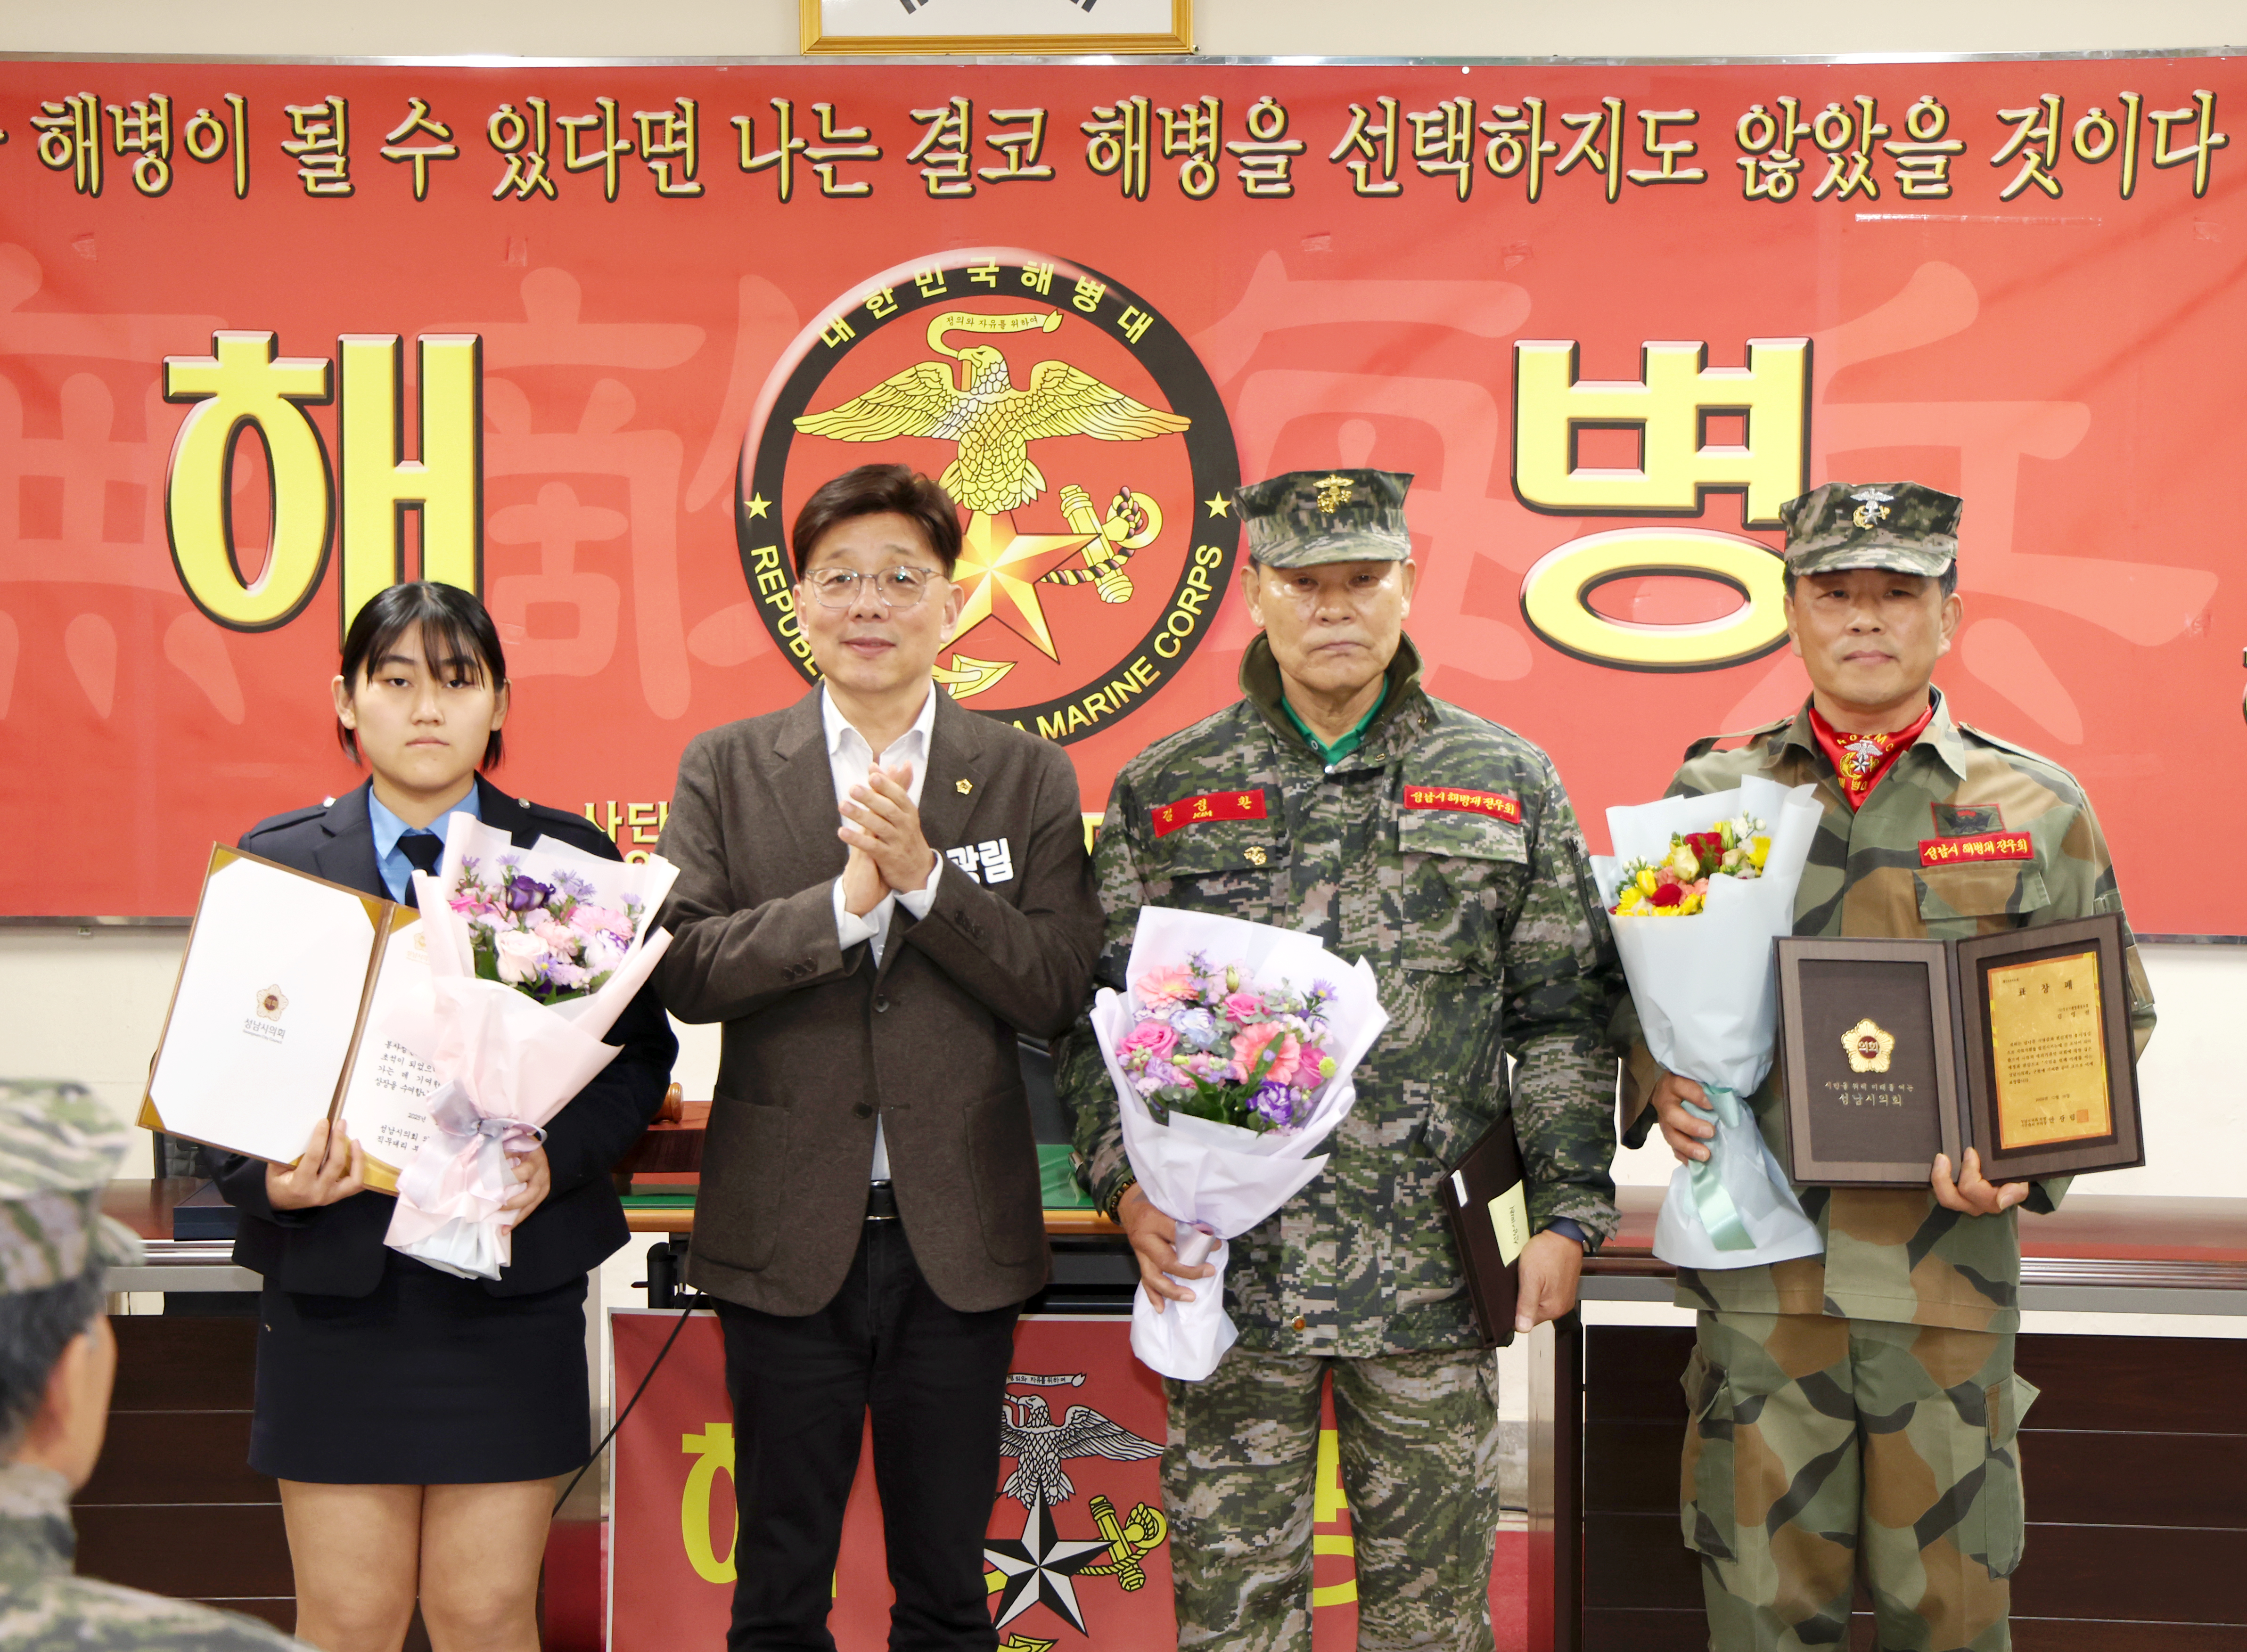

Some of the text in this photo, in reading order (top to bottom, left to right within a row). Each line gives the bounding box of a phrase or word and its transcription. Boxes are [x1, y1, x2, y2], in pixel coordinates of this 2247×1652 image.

[29, 90, 2229, 203] 해병이 될 수 있다면 나는 결코 해병을 선택하지도 않았을 것이다
[946, 315, 1038, 330] 정의와 자유를 위하여
[1512, 336, 1814, 675] 병
[1036, 655, 1161, 741] MARINE
[1154, 544, 1223, 659] CORPS
[245, 1018, 286, 1039] 성남시의회
[1858, 1041, 1879, 1053] 의회
[381, 1053, 404, 1065] 초석이
[378, 1065, 394, 1076] 가는
[1839, 1092, 1902, 1107] 성남시의회
[381, 1124, 418, 1142] 성남시의회
[377, 1136, 407, 1150] 직무대리
